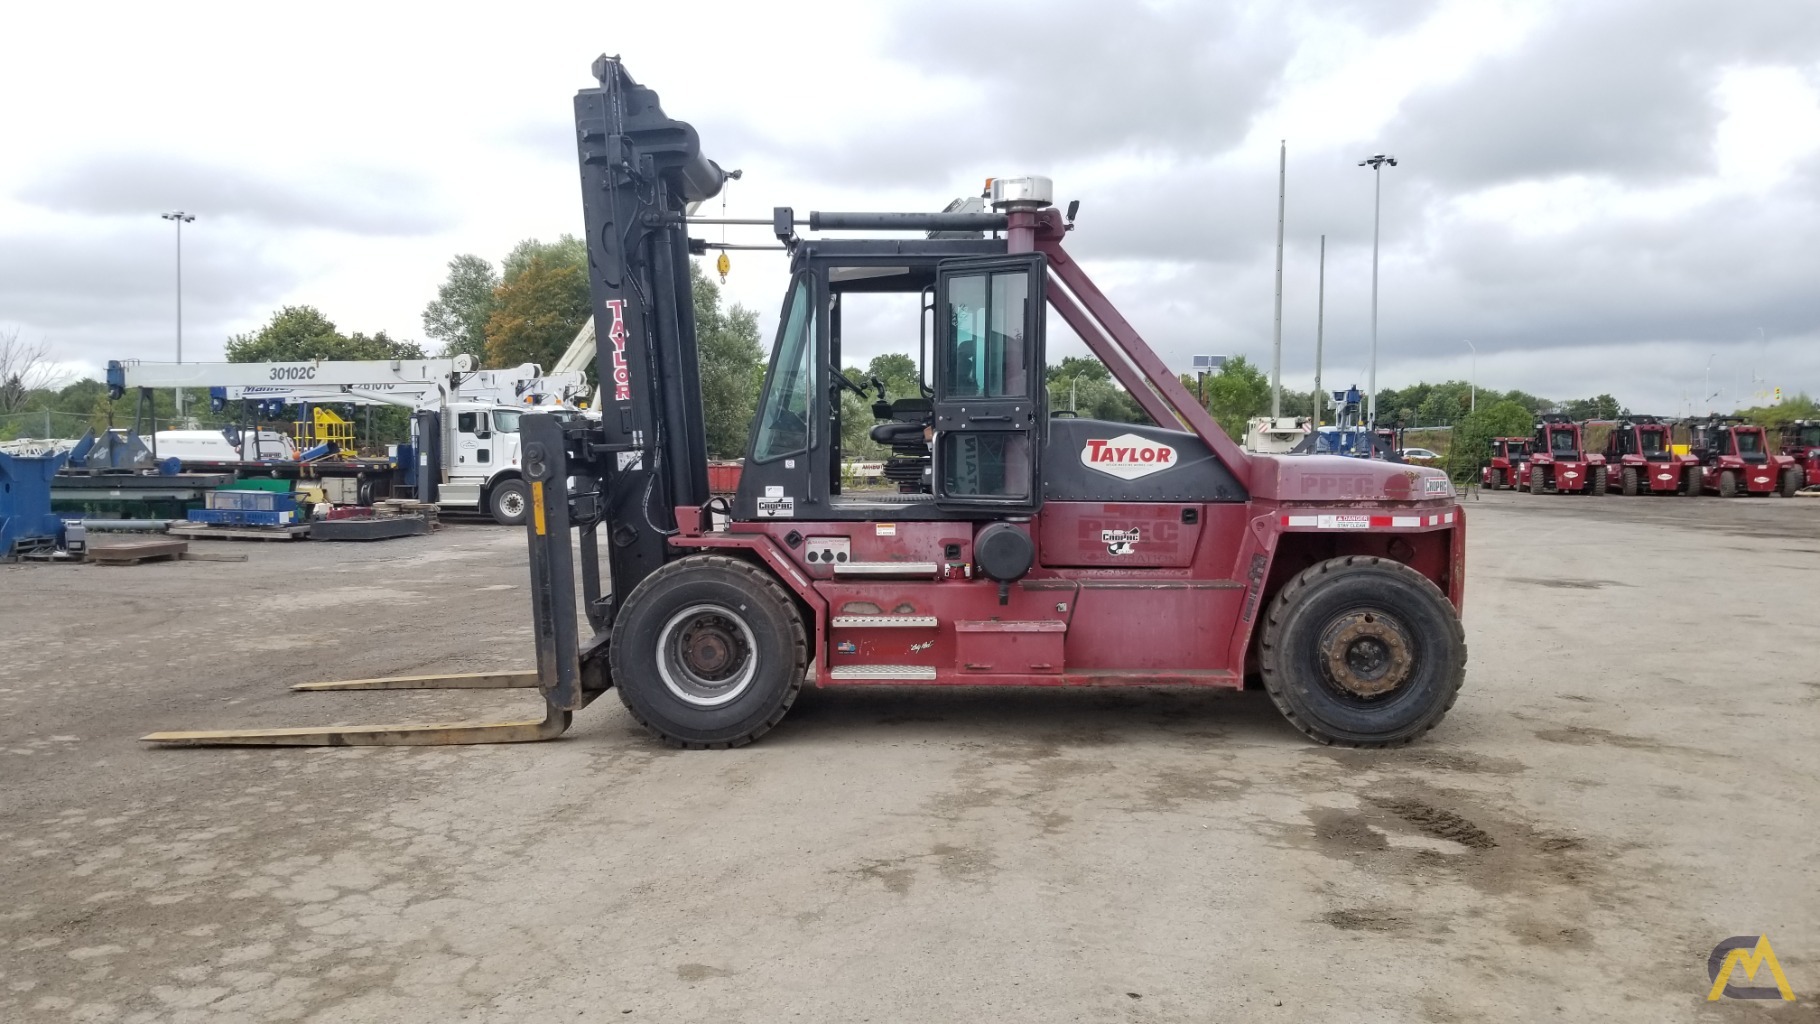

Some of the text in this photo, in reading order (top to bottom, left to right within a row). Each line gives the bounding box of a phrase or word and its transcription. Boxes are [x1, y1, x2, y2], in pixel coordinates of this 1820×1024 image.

[605, 299, 631, 401] TAYLOR
[269, 366, 316, 381] 30102C
[1087, 440, 1172, 463] TAYLOR
